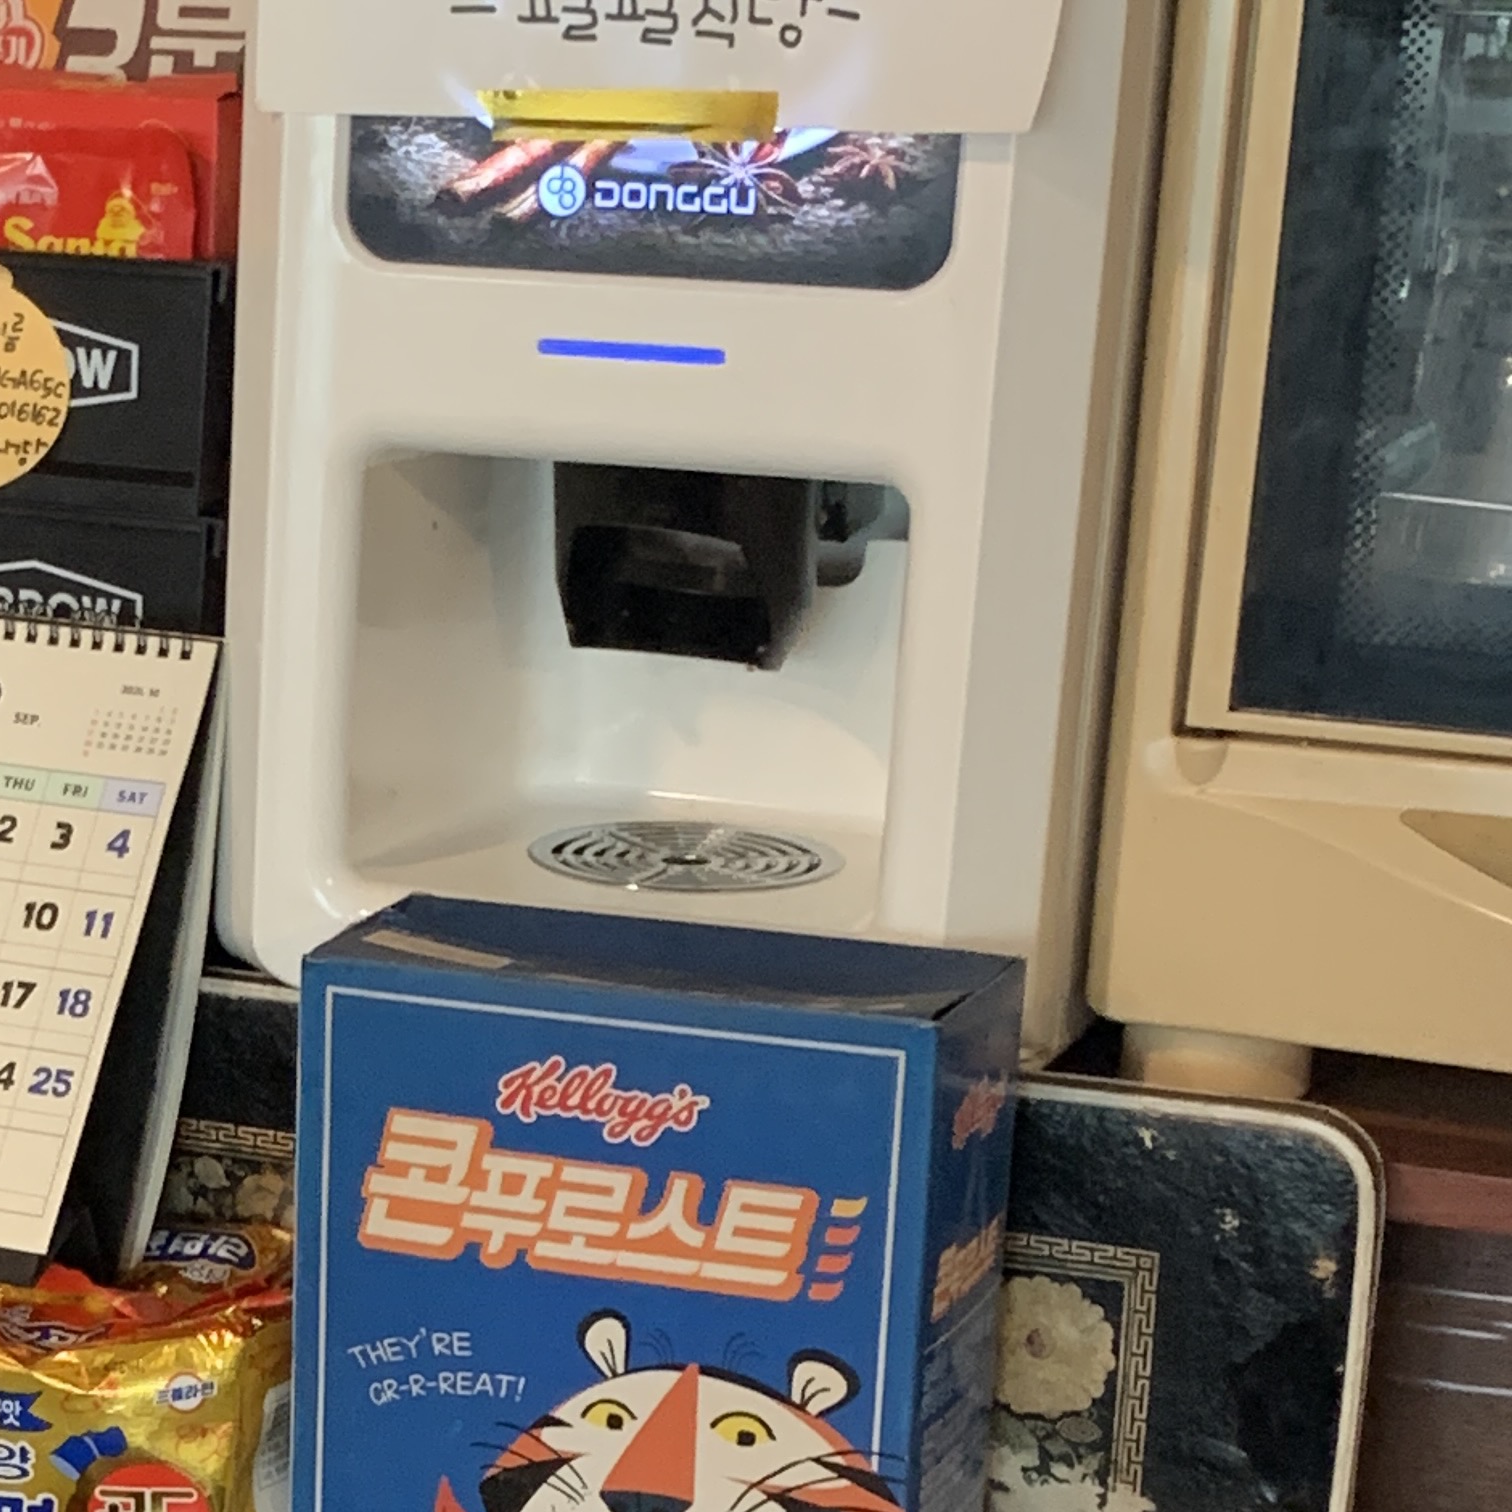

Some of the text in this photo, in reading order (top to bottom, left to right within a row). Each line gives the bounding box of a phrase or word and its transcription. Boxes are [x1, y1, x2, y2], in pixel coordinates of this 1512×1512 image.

[594, 180, 756, 215] DONGGU
[3, 774, 36, 792] THU
[62, 782, 89, 799] FRI
[117, 789, 149, 805] SAT
[49, 822, 74, 850] 3
[105, 828, 131, 858] 4
[22, 902, 59, 931] 10
[83, 909, 115, 939] 11
[0, 979, 37, 1009] 17
[57, 987, 91, 1018] 18
[27, 1066, 74, 1097] 25
[496, 1055, 710, 1146] Kellogg's
[358, 1108, 820, 1302] 콘푸로스트
[346, 1330, 473, 1369] THEY'RE
[368, 1372, 526, 1405] GR-R-REAT!
